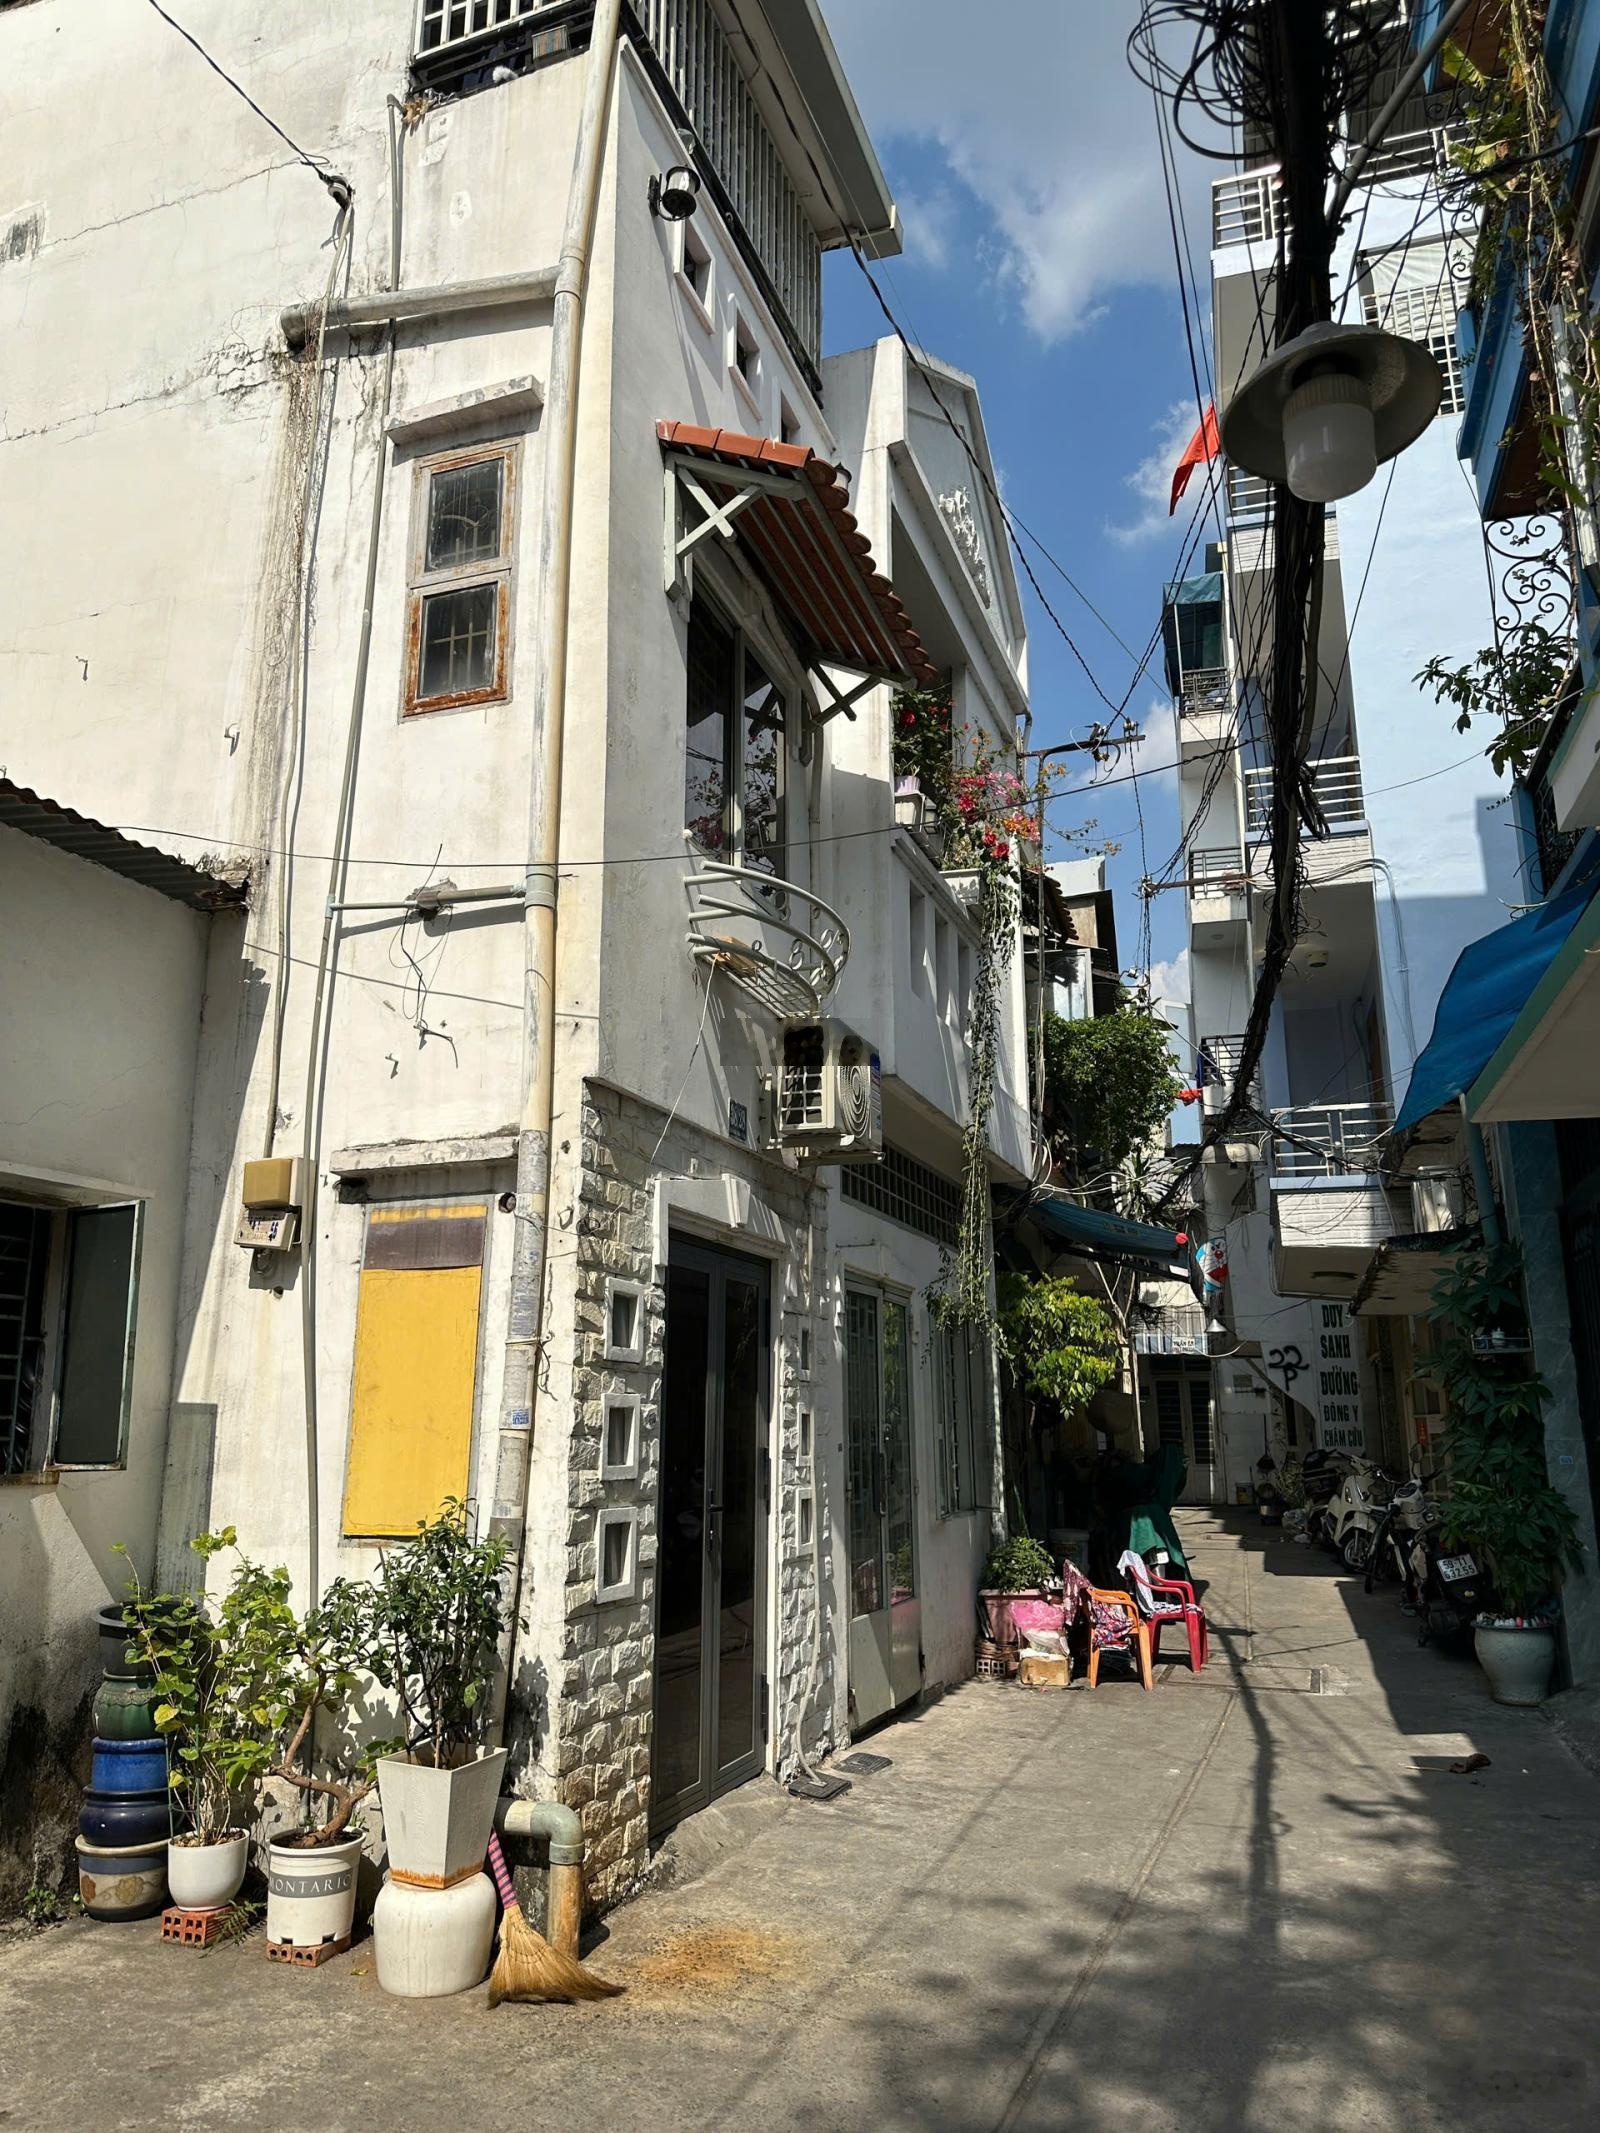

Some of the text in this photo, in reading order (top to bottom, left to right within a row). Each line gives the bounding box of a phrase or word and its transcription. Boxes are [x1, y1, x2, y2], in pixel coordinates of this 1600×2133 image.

[1321, 1304, 1344, 1328] DUY
[1320, 1334, 1351, 1359] SANH
[1323, 1401, 1359, 1422] ĐÔNG Y
